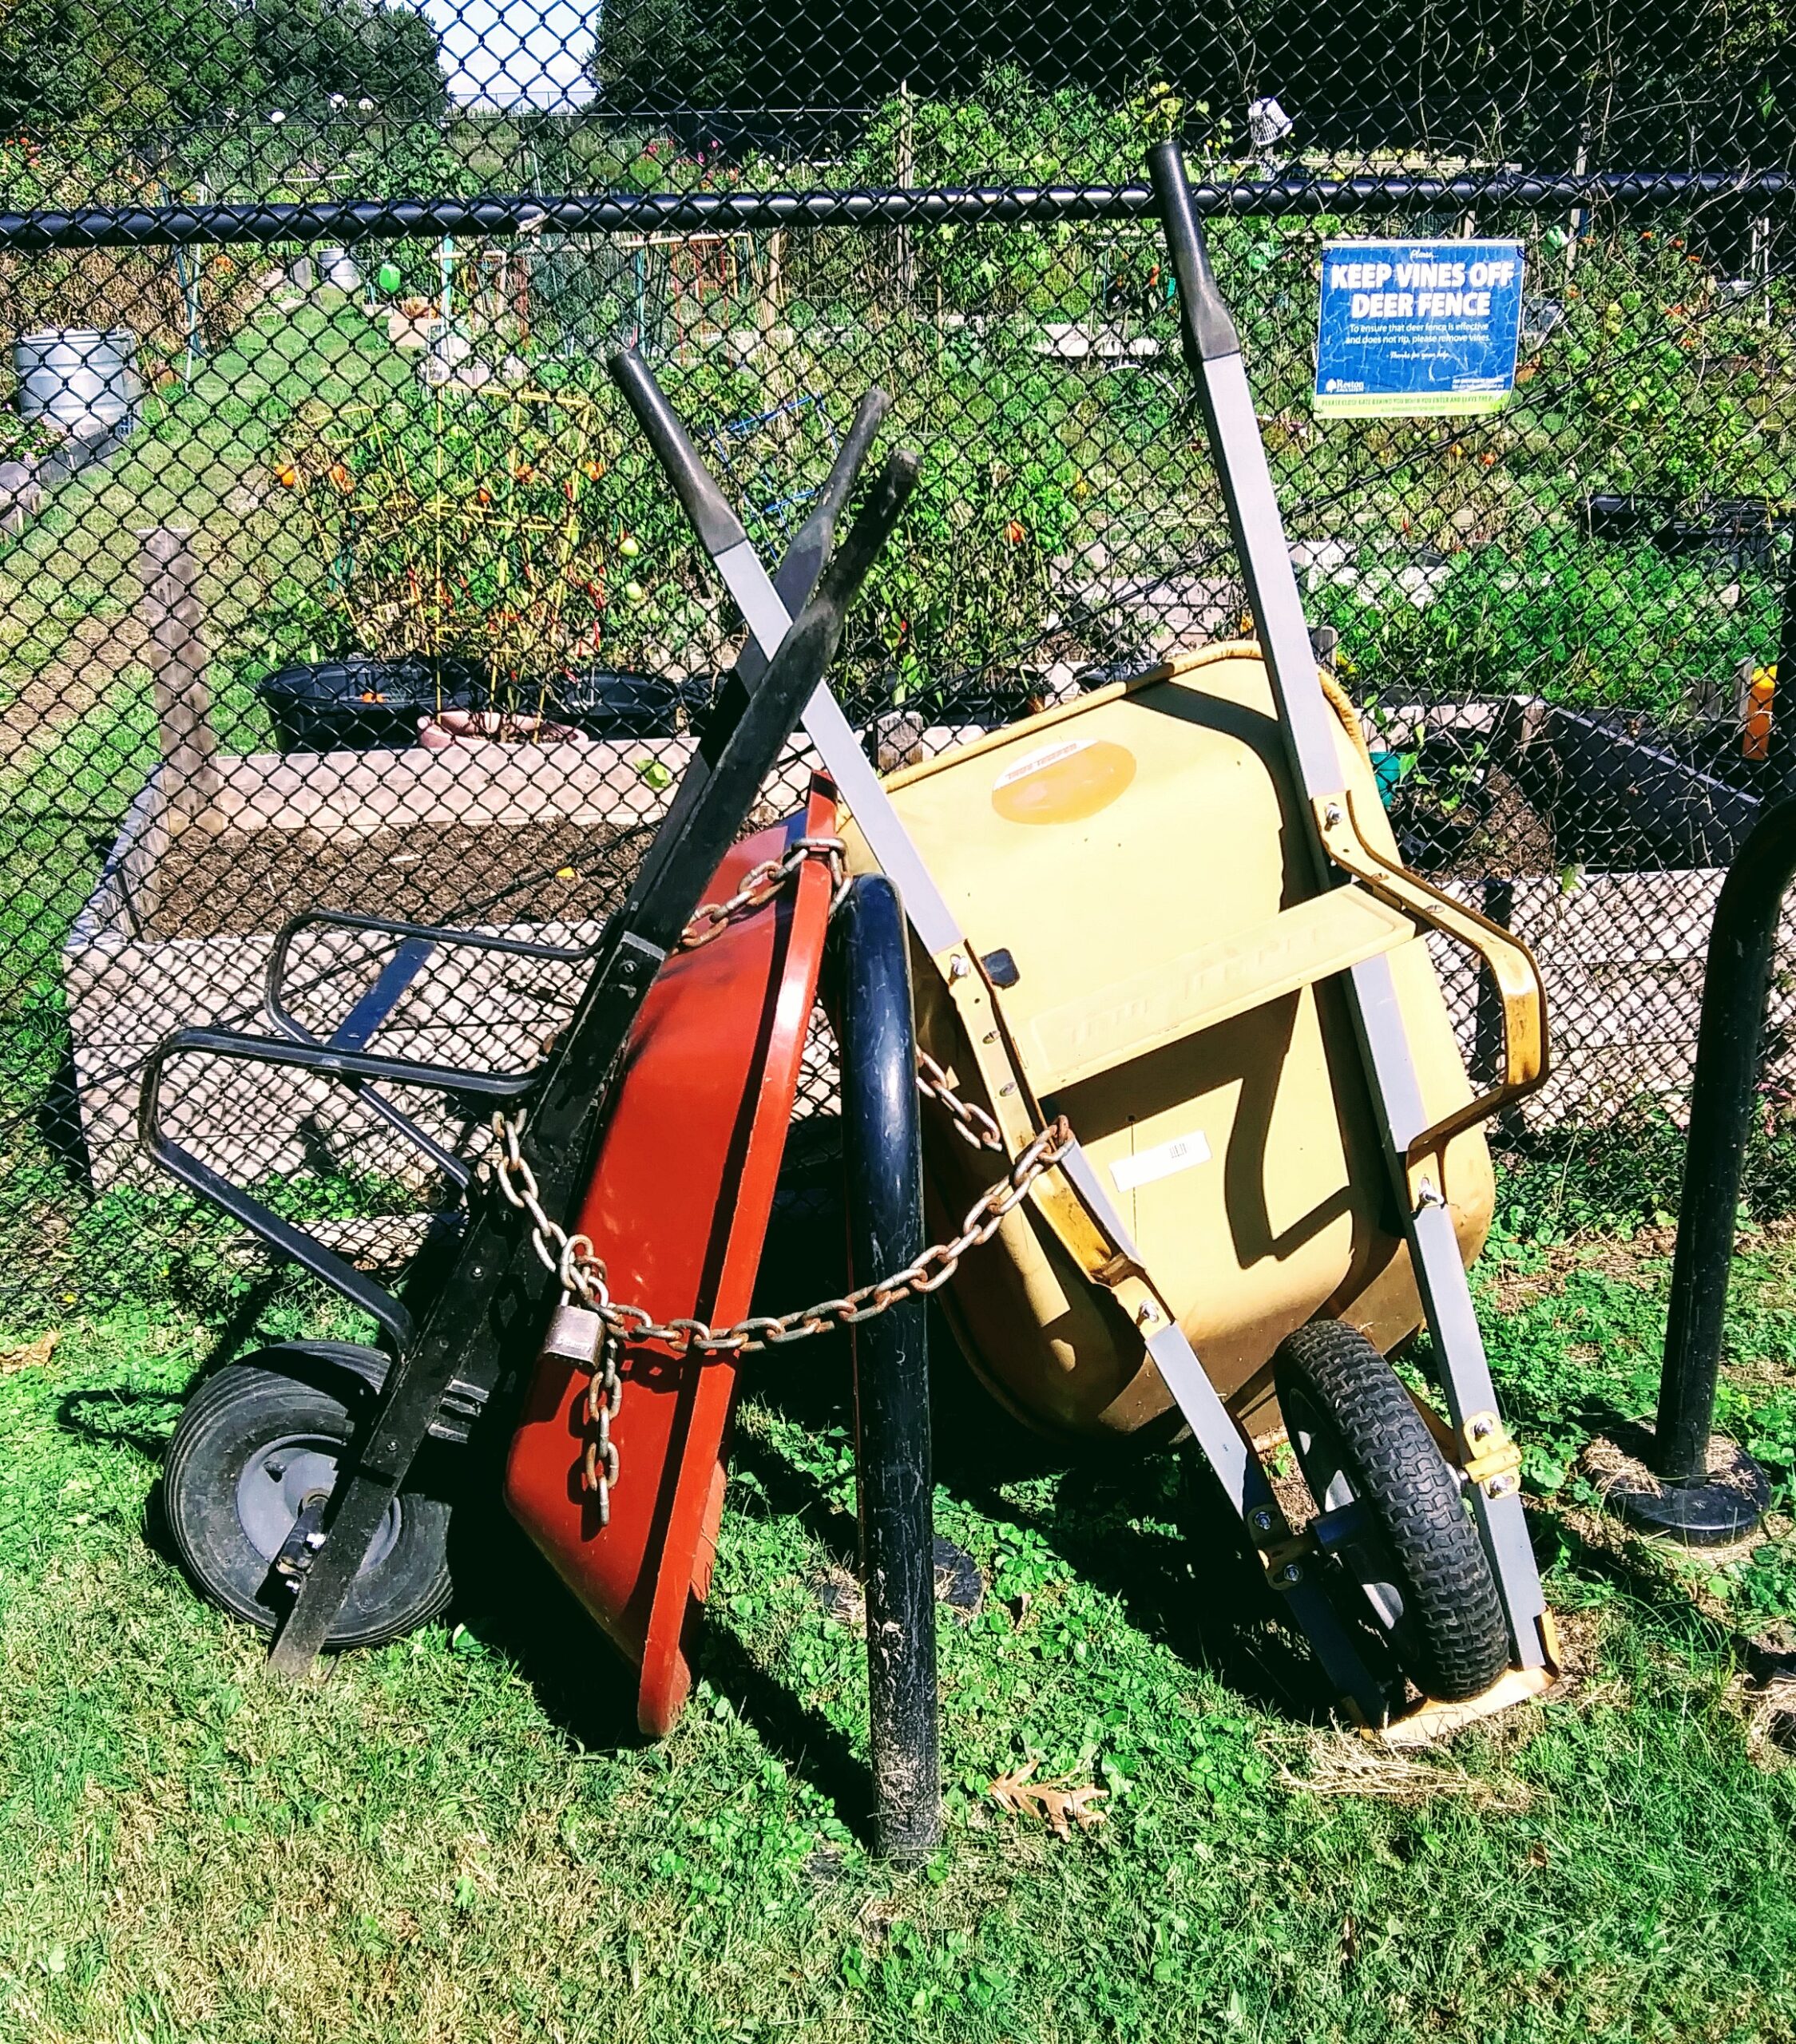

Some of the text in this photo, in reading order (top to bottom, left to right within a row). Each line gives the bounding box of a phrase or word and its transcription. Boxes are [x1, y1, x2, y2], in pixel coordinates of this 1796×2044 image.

[1330, 262, 1515, 289] KEEP VINES OFF
[1351, 291, 1492, 319] DEER FENCE
[1350, 324, 1359, 333] To
[1389, 323, 1405, 332] that
[1425, 323, 1447, 331] fence
[1346, 335, 1362, 344] and
[1362, 335, 1382, 344] does
[1398, 335, 1411, 345] rip,
[1412, 334, 1436, 345] please
[1469, 334, 1491, 343] vines.
